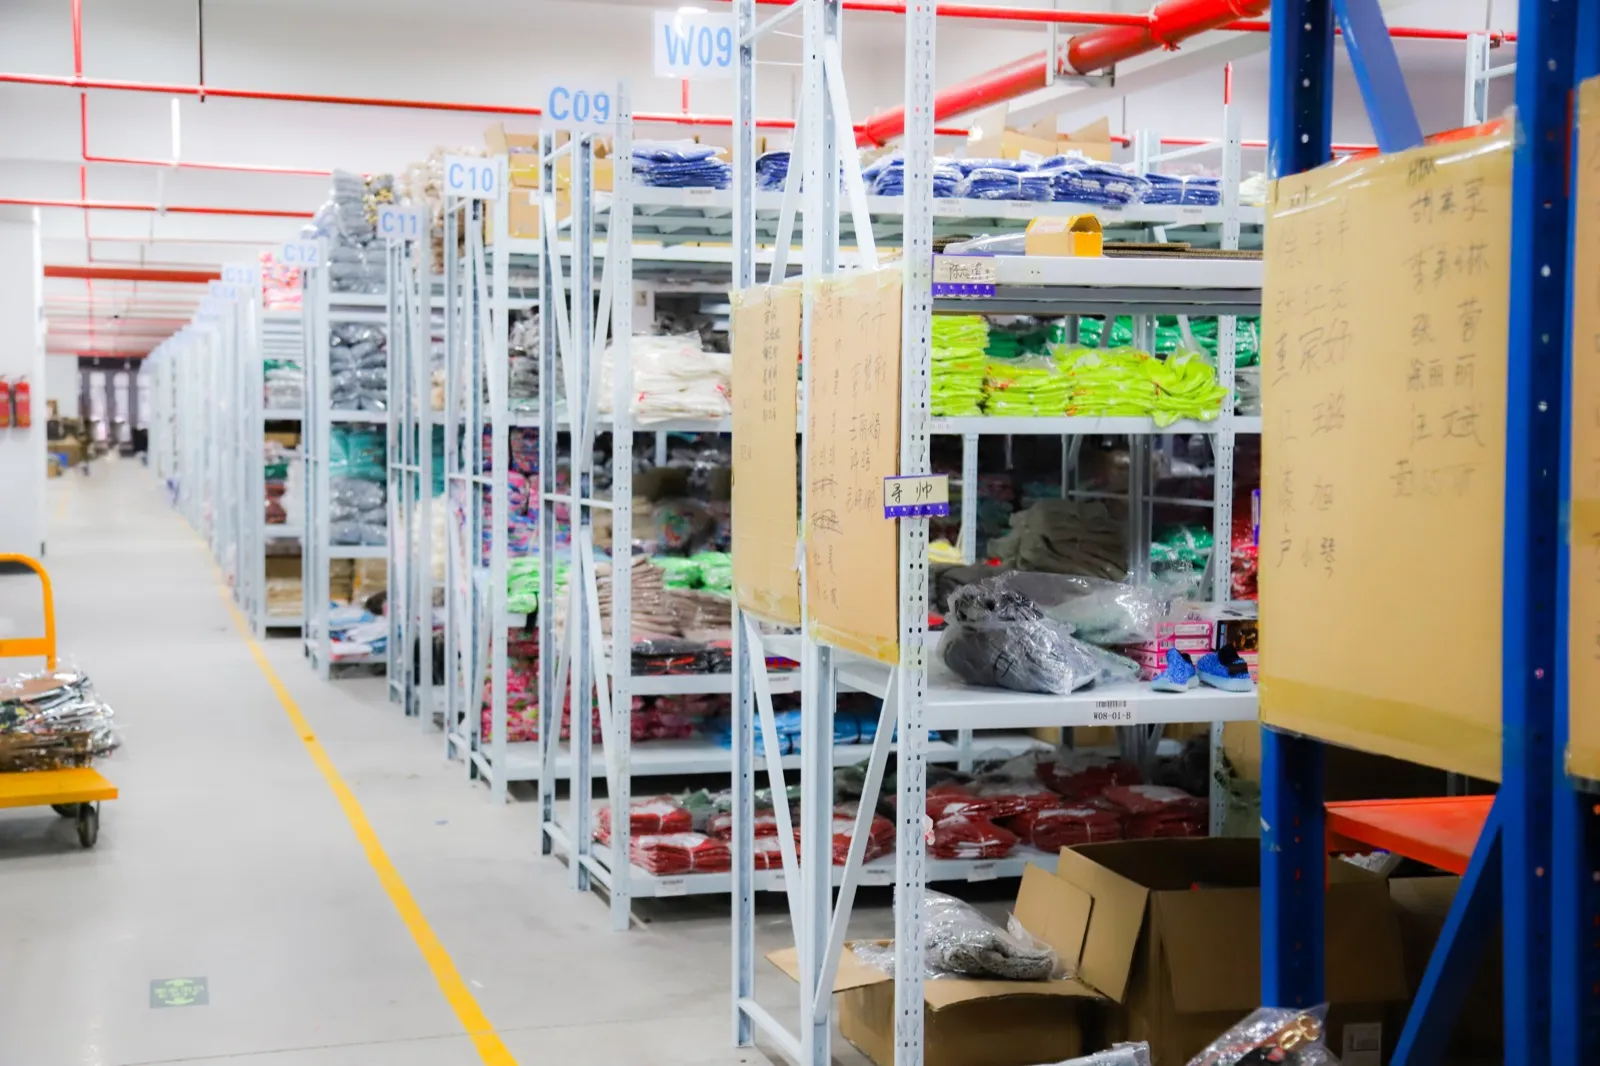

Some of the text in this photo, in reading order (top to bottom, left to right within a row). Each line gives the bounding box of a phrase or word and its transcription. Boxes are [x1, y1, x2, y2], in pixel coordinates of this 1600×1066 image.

[664, 24, 733, 67] W09
[548, 86, 610, 125] C09
[449, 162, 494, 192] C10
[382, 211, 417, 235] C11
[283, 244, 317, 263] C12
[1093, 711, 1131, 720] W08-01-B
